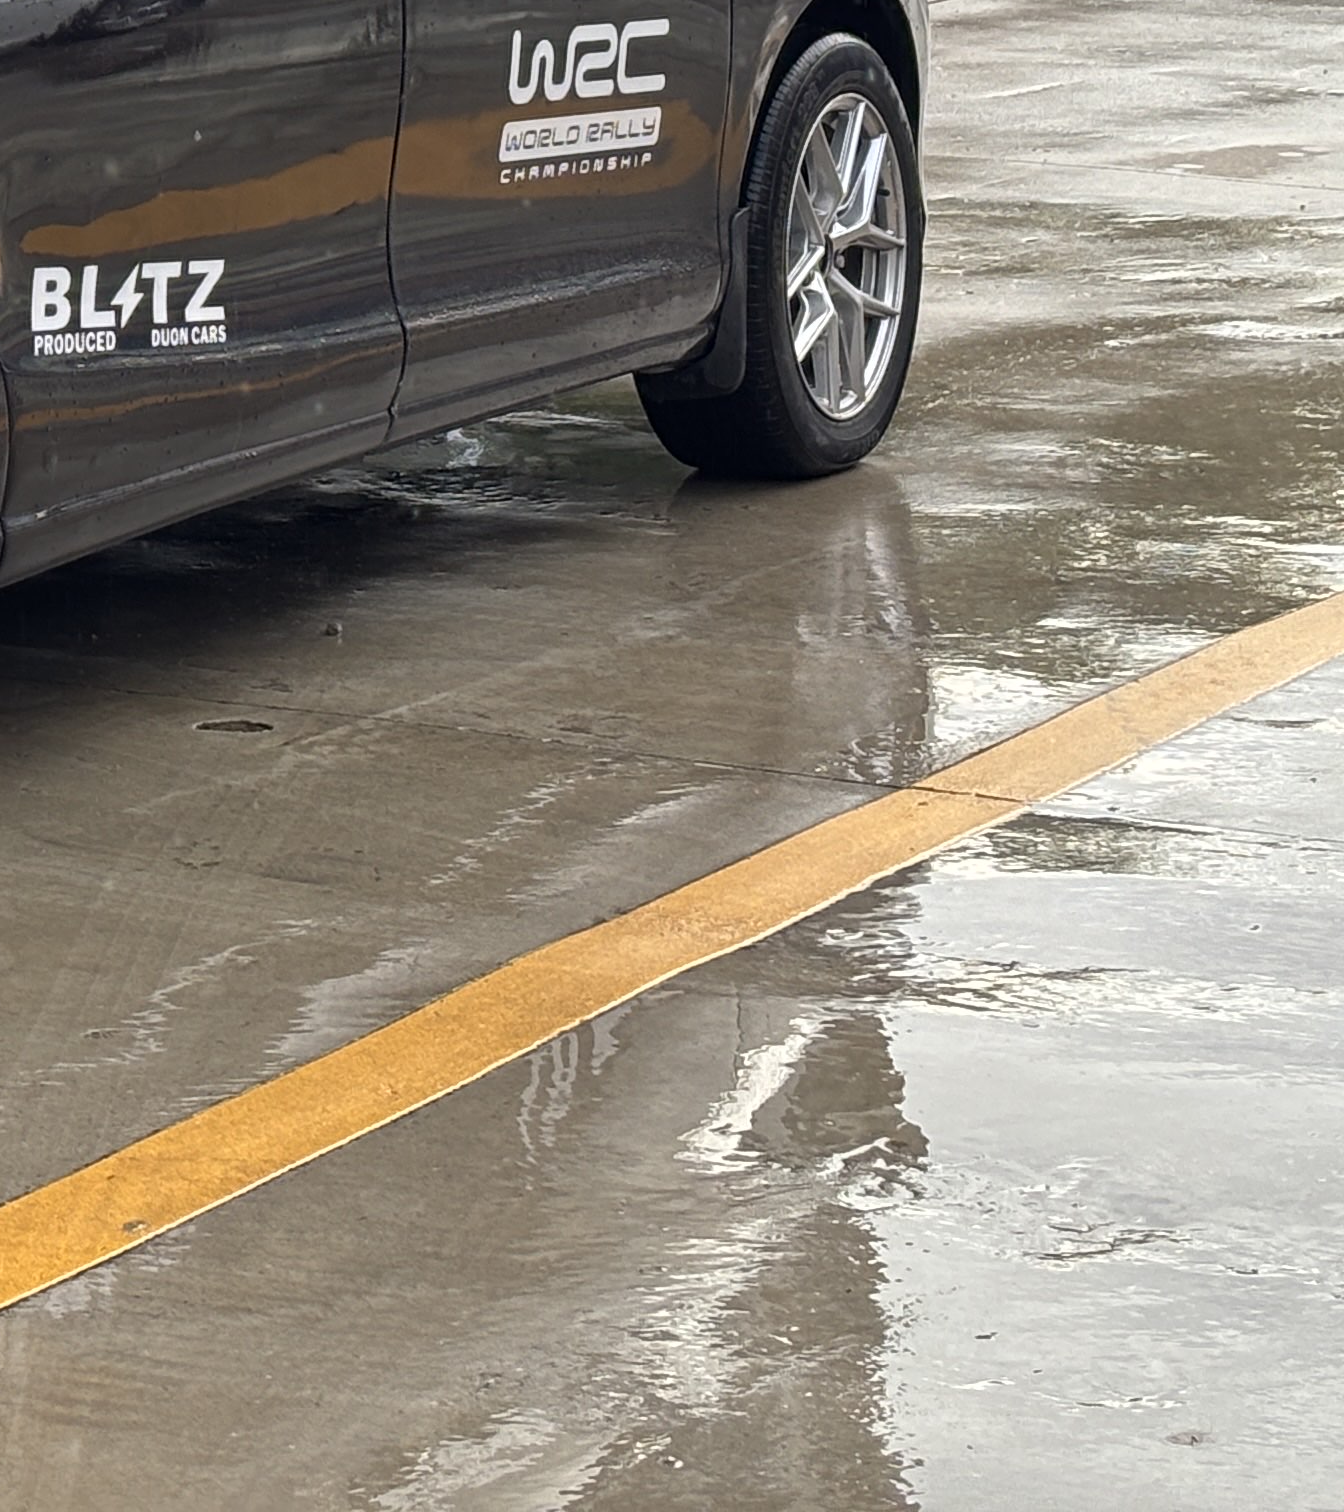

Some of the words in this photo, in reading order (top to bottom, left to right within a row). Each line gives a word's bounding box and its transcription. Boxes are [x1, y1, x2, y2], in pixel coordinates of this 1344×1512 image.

[509, 16, 670, 105] WRC
[505, 125, 580, 152] WORLD
[585, 116, 657, 144] RALLY
[500, 152, 652, 184] CHAMPIONSHIP
[34, 330, 116, 357] PRODUCED
[151, 326, 189, 348] DUON
[191, 324, 227, 345] CARS
